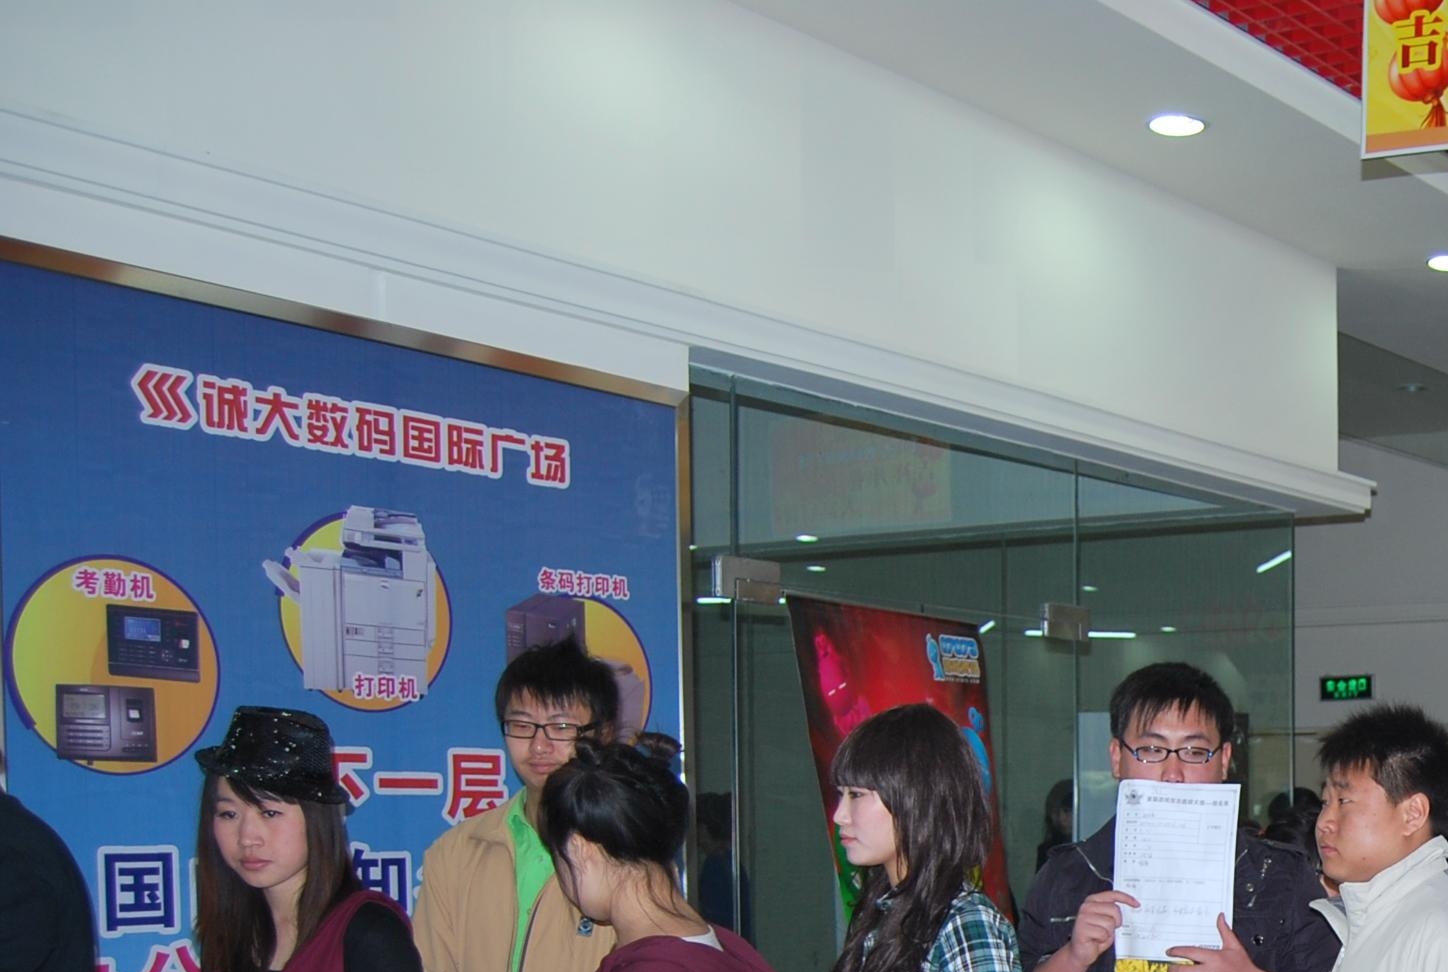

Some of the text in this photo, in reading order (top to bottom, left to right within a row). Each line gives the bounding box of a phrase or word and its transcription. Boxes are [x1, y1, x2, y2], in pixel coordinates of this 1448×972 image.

[200, 378, 570, 487] 诚大数码国际广场
[74, 568, 156, 600] 考勤机
[538, 567, 630, 599] 条码打印机
[354, 674, 419, 700] 打印机
